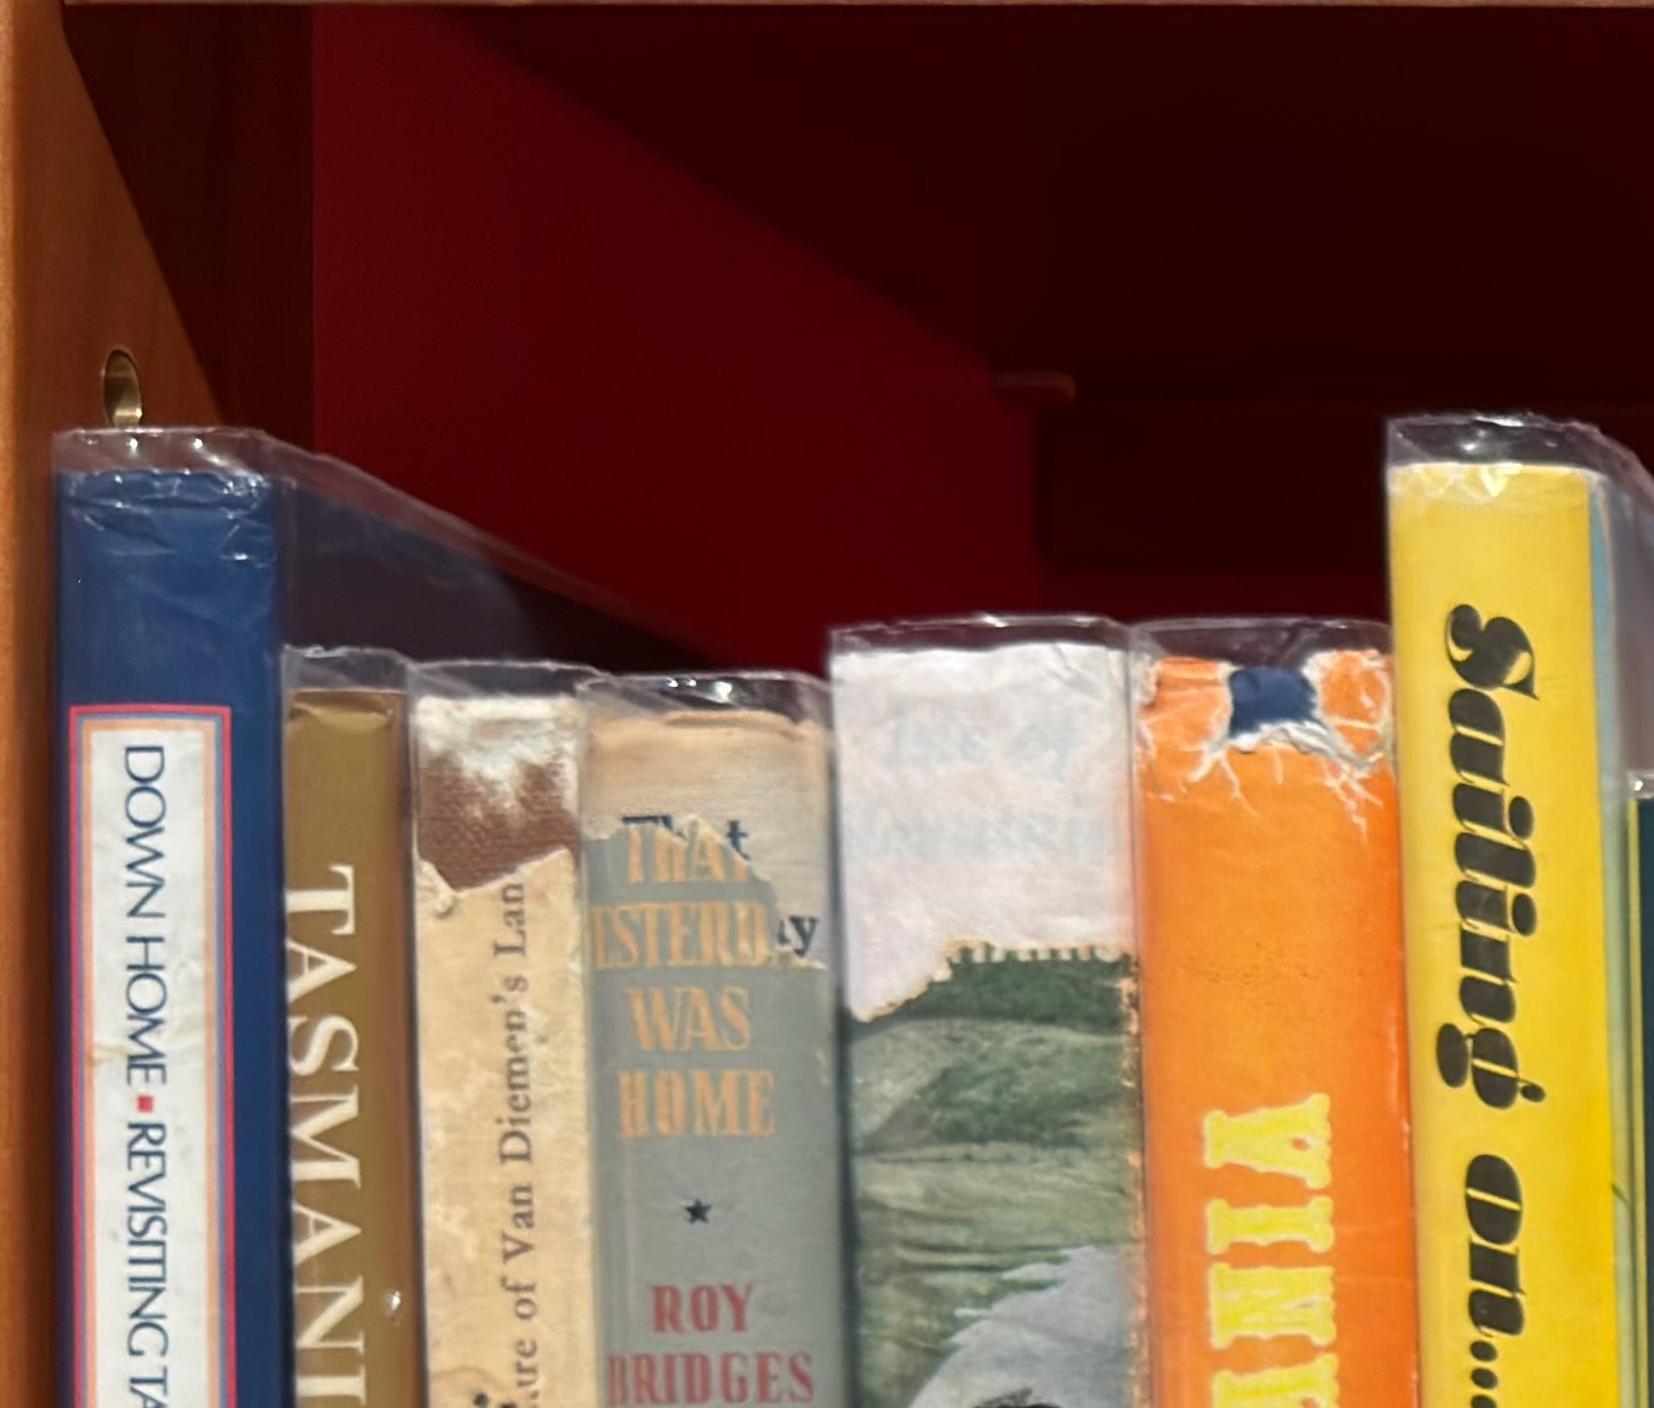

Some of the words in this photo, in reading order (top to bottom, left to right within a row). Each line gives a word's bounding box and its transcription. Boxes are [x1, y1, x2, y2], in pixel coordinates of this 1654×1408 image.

[124, 744, 166, 918] DOWN
[1436, 601, 1546, 1111] Sailing
[493, 882, 527, 958] Lan
[125, 935, 167, 1088] HOME
[627, 986, 751, 1053] WAS
[493, 974, 534, 1165] Diemen's
[618, 1067, 776, 1138] HOME
[125, 1122, 170, 1358] REVISITING
[501, 1183, 537, 1262] Van
[501, 1277, 538, 1322] of
[651, 1282, 755, 1334] ROY
[607, 1350, 815, 1407] BRIDGES
